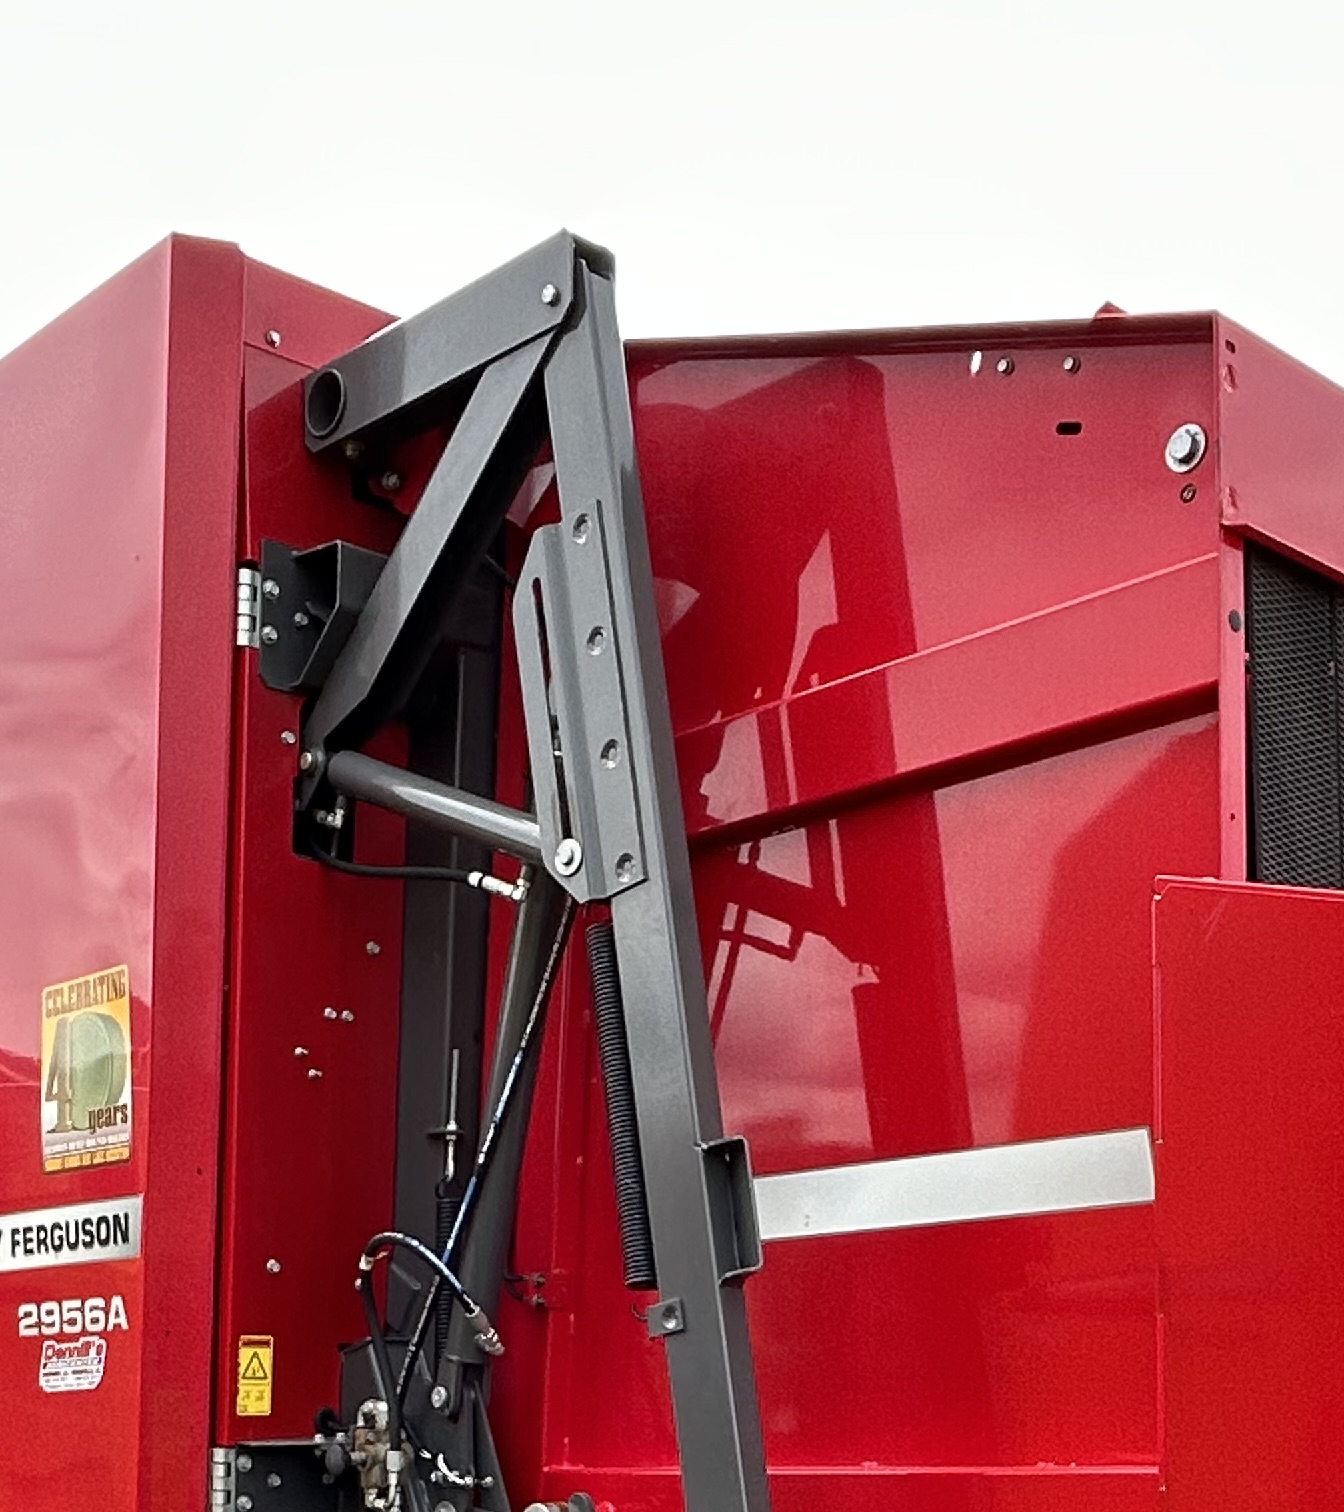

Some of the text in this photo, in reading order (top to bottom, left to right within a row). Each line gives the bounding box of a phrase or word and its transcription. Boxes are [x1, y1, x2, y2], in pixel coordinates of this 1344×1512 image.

[45, 968, 126, 1018] CELEBRATING
[88, 1103, 128, 1134] years
[10, 1213, 130, 1258] FERGUSON
[17, 1295, 129, 1338] 2956A
